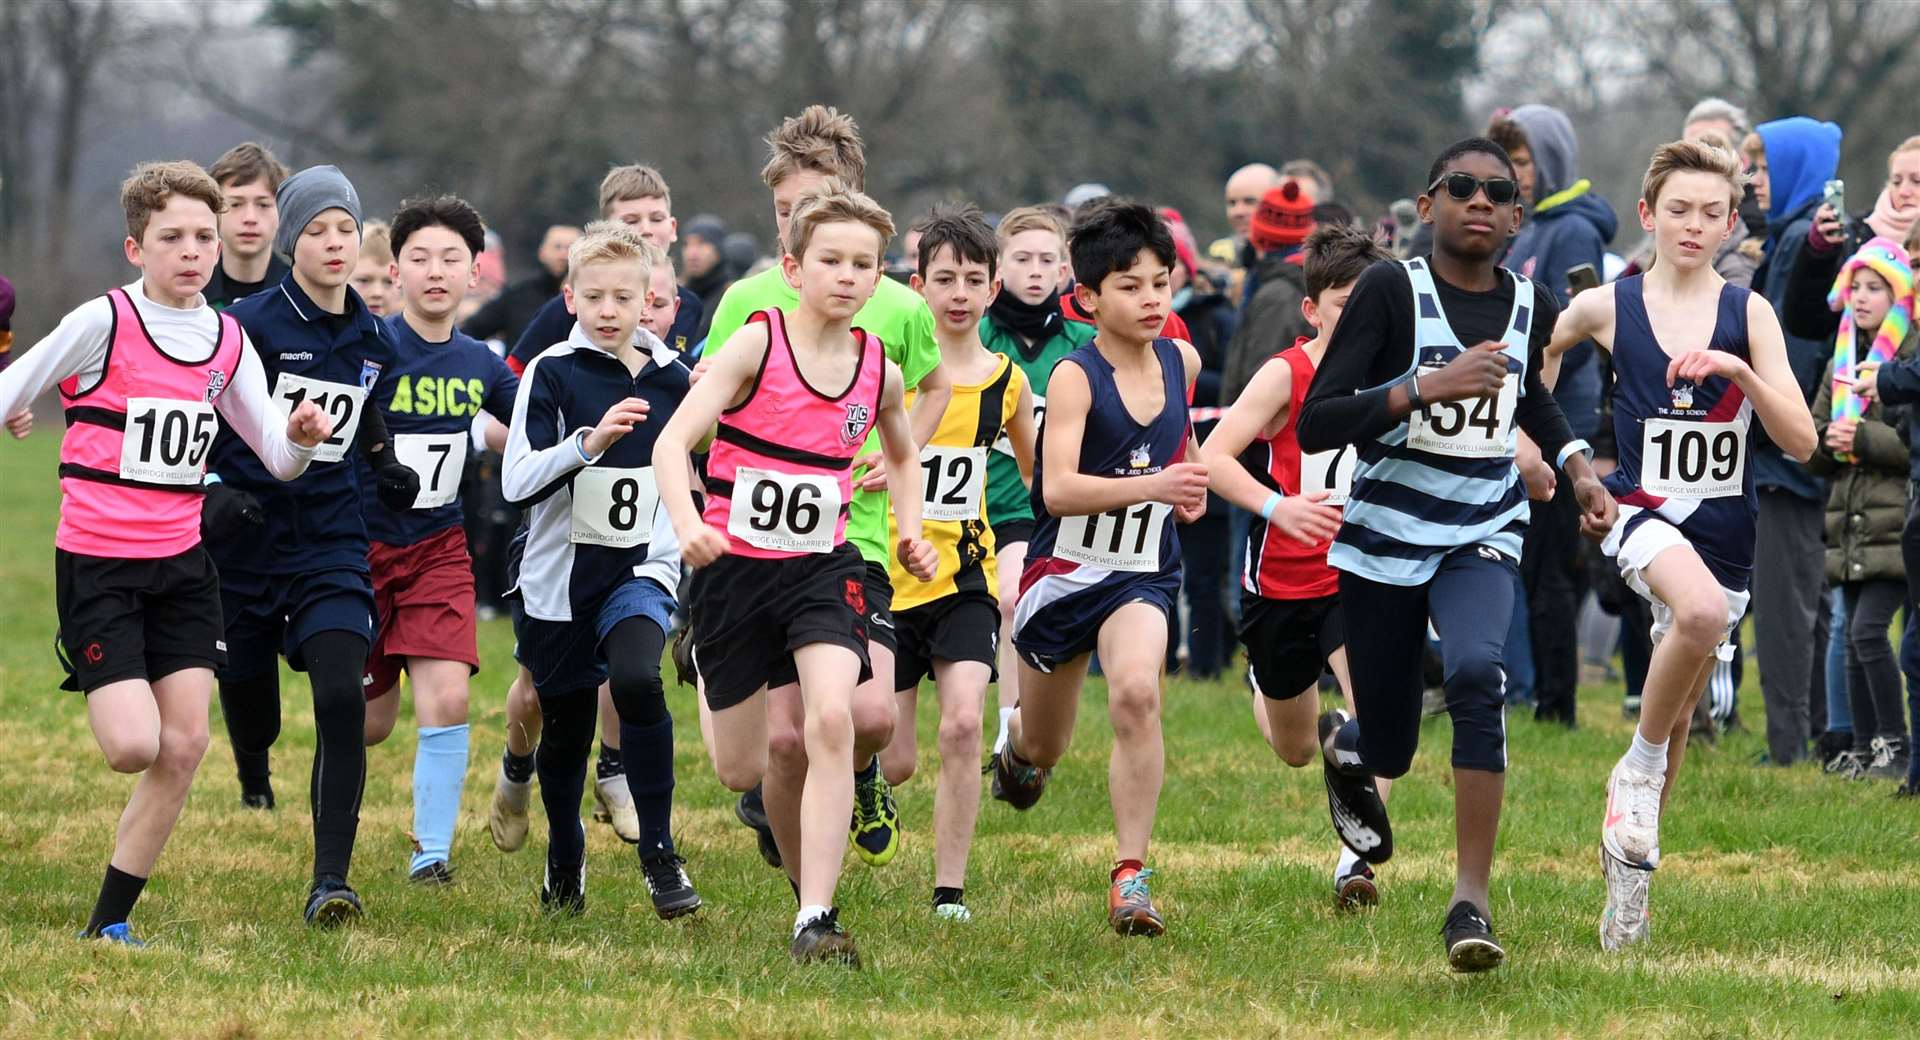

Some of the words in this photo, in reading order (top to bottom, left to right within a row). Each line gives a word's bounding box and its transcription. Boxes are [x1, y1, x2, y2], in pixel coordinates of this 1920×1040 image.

[280, 351, 313, 361] macron
[389, 374, 484, 416] ASICS
[848, 406, 867, 420] YC
[1430, 392, 1500, 440] 54
[1658, 407, 1669, 415] THE
[133, 408, 214, 467] 105
[1650, 429, 1739, 483] 109
[427, 443, 451, 492] 7
[920, 454, 973, 505] 12
[1114, 467, 1126, 475] THE
[608, 477, 639, 531] 8
[749, 479, 822, 535] 96
[573, 531, 613, 542] TUNBRIDGE
[771, 537, 795, 546] WELLS
[796, 539, 832, 547] HARRIERS
[1081, 502, 1154, 555] 111
[1057, 546, 1098, 562] TUNBRIDGE
[1099, 557, 1122, 566] WELLS
[1123, 559, 1157, 567] HARRIERS
